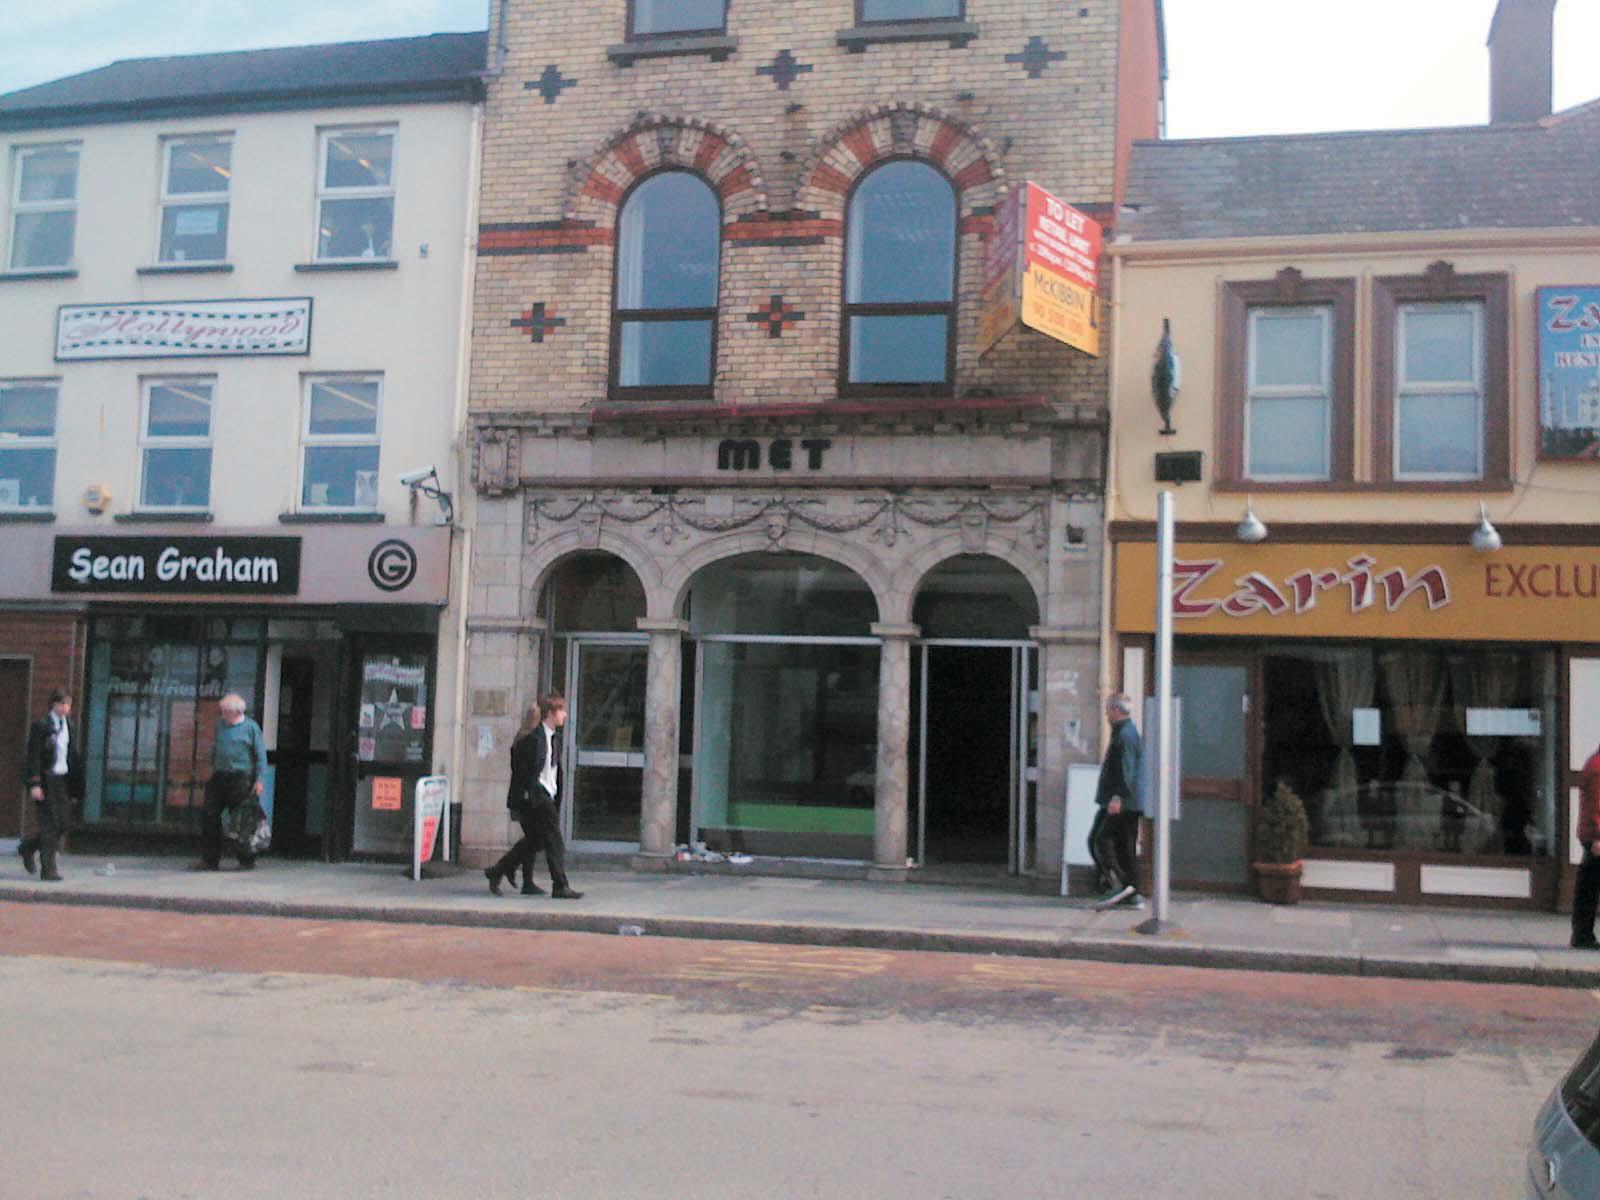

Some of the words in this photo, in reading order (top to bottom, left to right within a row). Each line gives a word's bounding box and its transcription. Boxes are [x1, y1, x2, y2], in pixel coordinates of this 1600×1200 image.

[68, 546, 145, 583] Sean
[157, 546, 279, 583] Graham
[1172, 552, 1451, 617] Zarin
[1482, 563, 1600, 599] EXCLU
